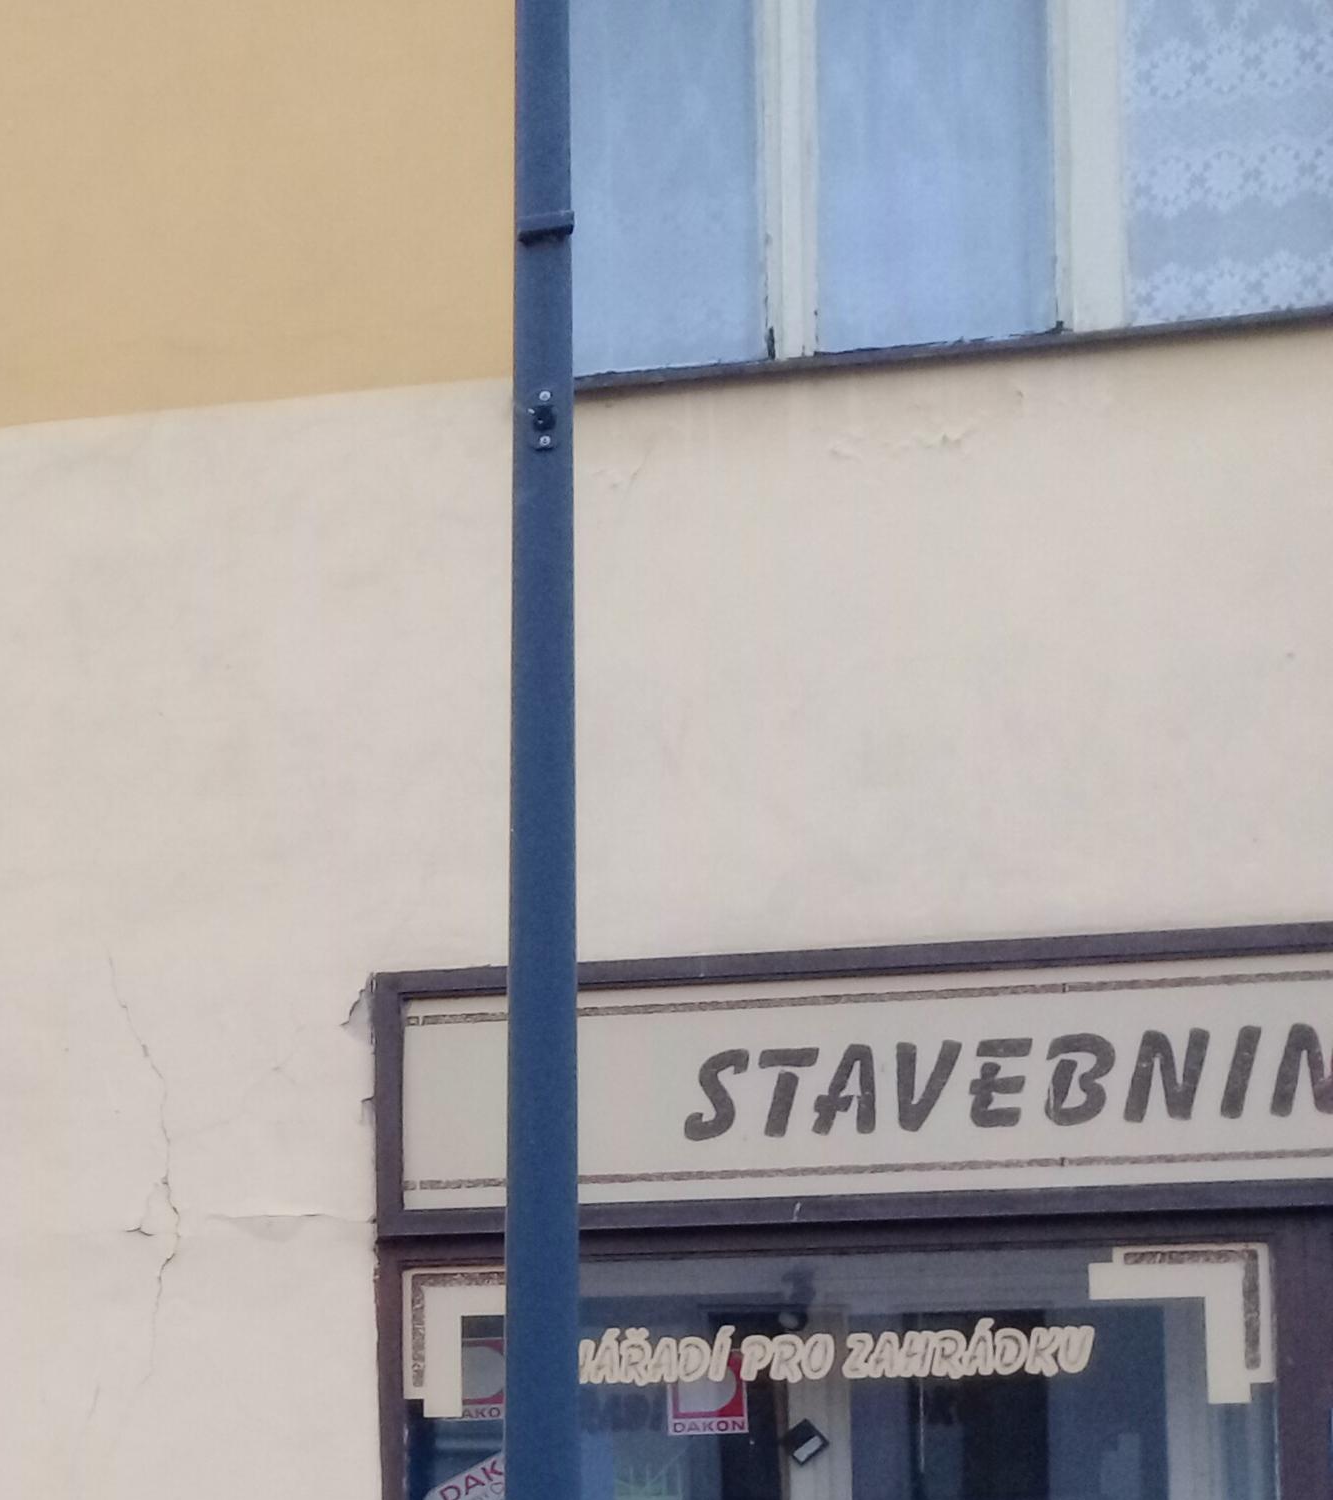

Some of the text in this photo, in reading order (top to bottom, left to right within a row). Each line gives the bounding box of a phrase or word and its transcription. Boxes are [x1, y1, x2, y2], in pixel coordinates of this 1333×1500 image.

[740, 1333, 834, 1382] PRO
[841, 1317, 1095, 1380] ZAHRÁDKU
[673, 1419, 746, 1435] DAKON
